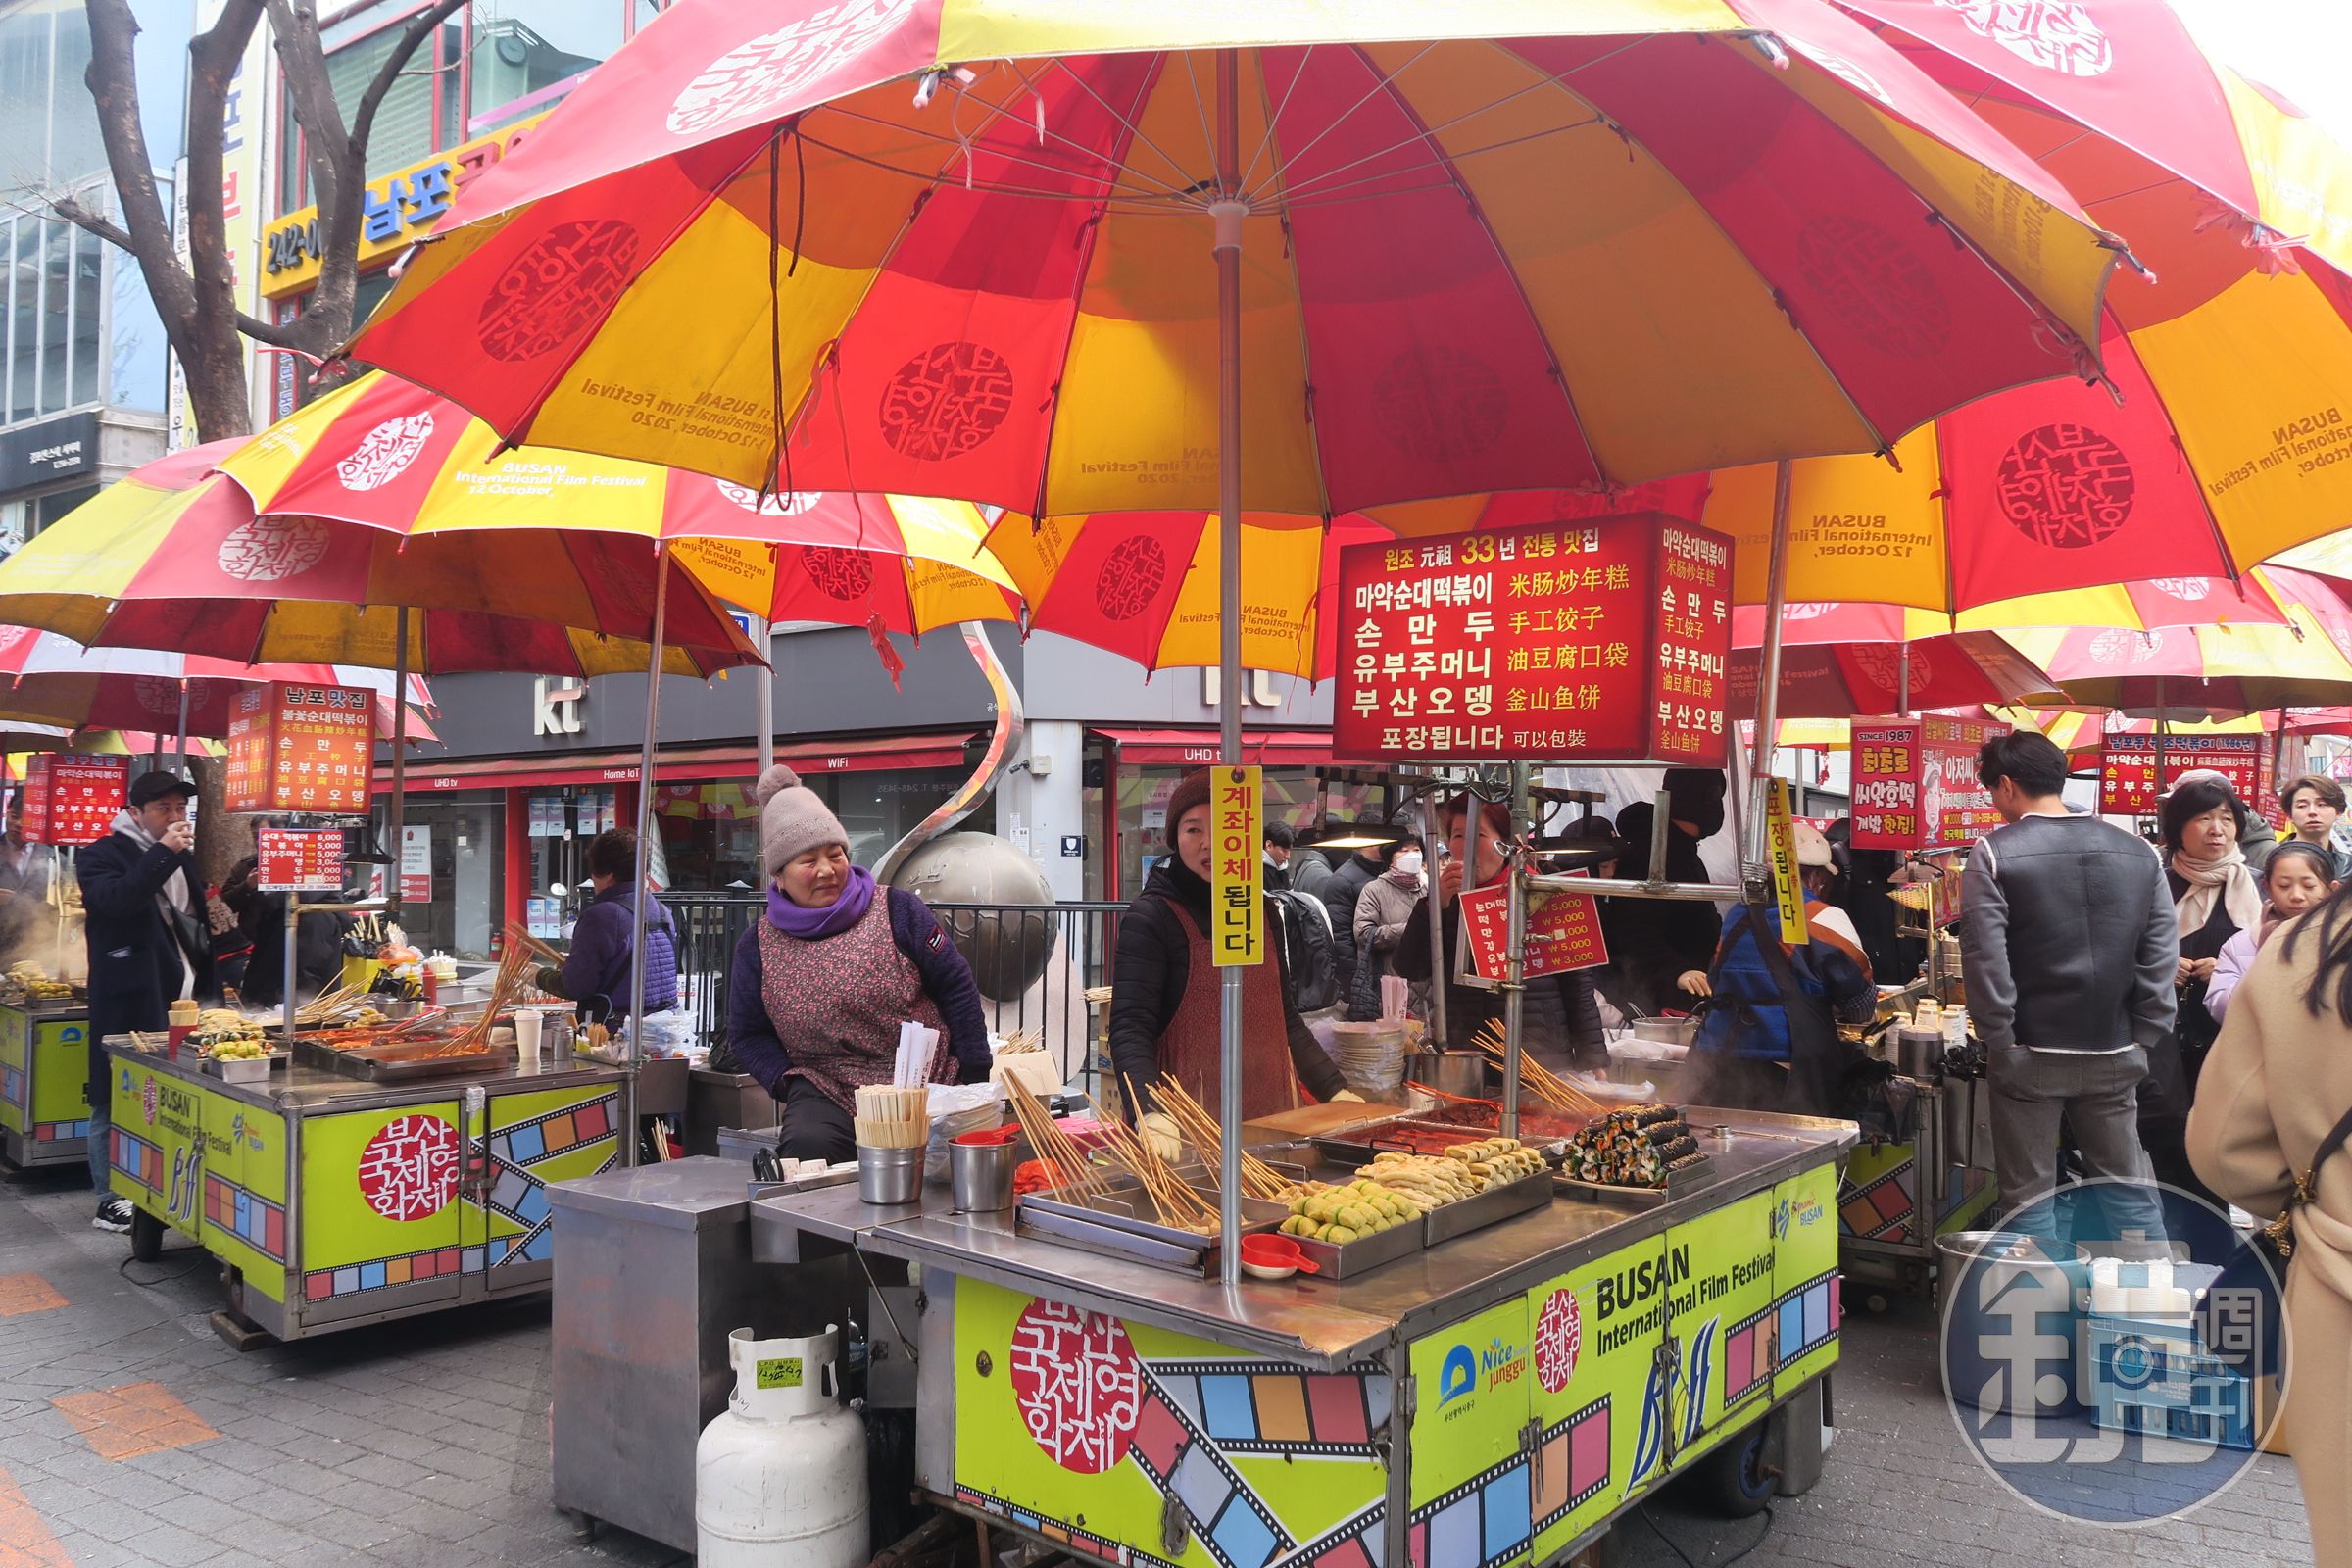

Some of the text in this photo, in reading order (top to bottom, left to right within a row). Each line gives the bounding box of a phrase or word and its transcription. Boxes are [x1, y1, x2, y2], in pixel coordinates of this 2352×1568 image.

[455, 471, 647, 487] International Film Festival
[502, 463, 568, 474] BUSAN
[1385, 548, 1415, 572] 원조
[1420, 545, 1452, 568] 元祖
[1522, 534, 1557, 559] 전통
[1563, 527, 1599, 555] 맛집
[1662, 528, 1727, 570] 마약순대떡볶이
[1356, 572, 1493, 612] 마약순대떡볶이
[1507, 564, 1630, 598] 米肠炒年糕
[1508, 605, 1605, 634] 手工饺子
[1664, 613, 1704, 641] 手工饺子
[1353, 647, 1491, 683] 유부주머니
[1507, 642, 1629, 672] 油豆腐口袋
[1659, 642, 1725, 680] 유부주머니
[534, 675, 586, 735] kt
[1505, 685, 1601, 711] 釜山鱼饼
[282, 709, 368, 726] 불꽃순대떡볶이
[1380, 724, 1504, 751] 포장됩니다
[1858, 730, 1913, 742] SINCE 1987
[2109, 736, 2145, 749] 남포동
[278, 760, 366, 778] 유부주머니
[828, 757, 849, 769] WiFi
[1184, 749, 1212, 761] UHD
[1862, 746, 1909, 773] 최초로
[2106, 754, 2194, 767] 마약순대볶이
[434, 778, 450, 788] UHD
[604, 770, 625, 779] Home
[1945, 755, 1974, 784] 아저씨
[1854, 780, 1916, 808] 씨앗호떡
[1223, 786, 1255, 956] 계좌이체됩니다
[160, 1086, 191, 1118] BUSAN
[1800, 1204, 1822, 1225] BUSAN
[1597, 1244, 1690, 1321] BUSAN
[1597, 1246, 1776, 1357] International Film Festival
[1482, 1344, 1512, 1375] Nice
